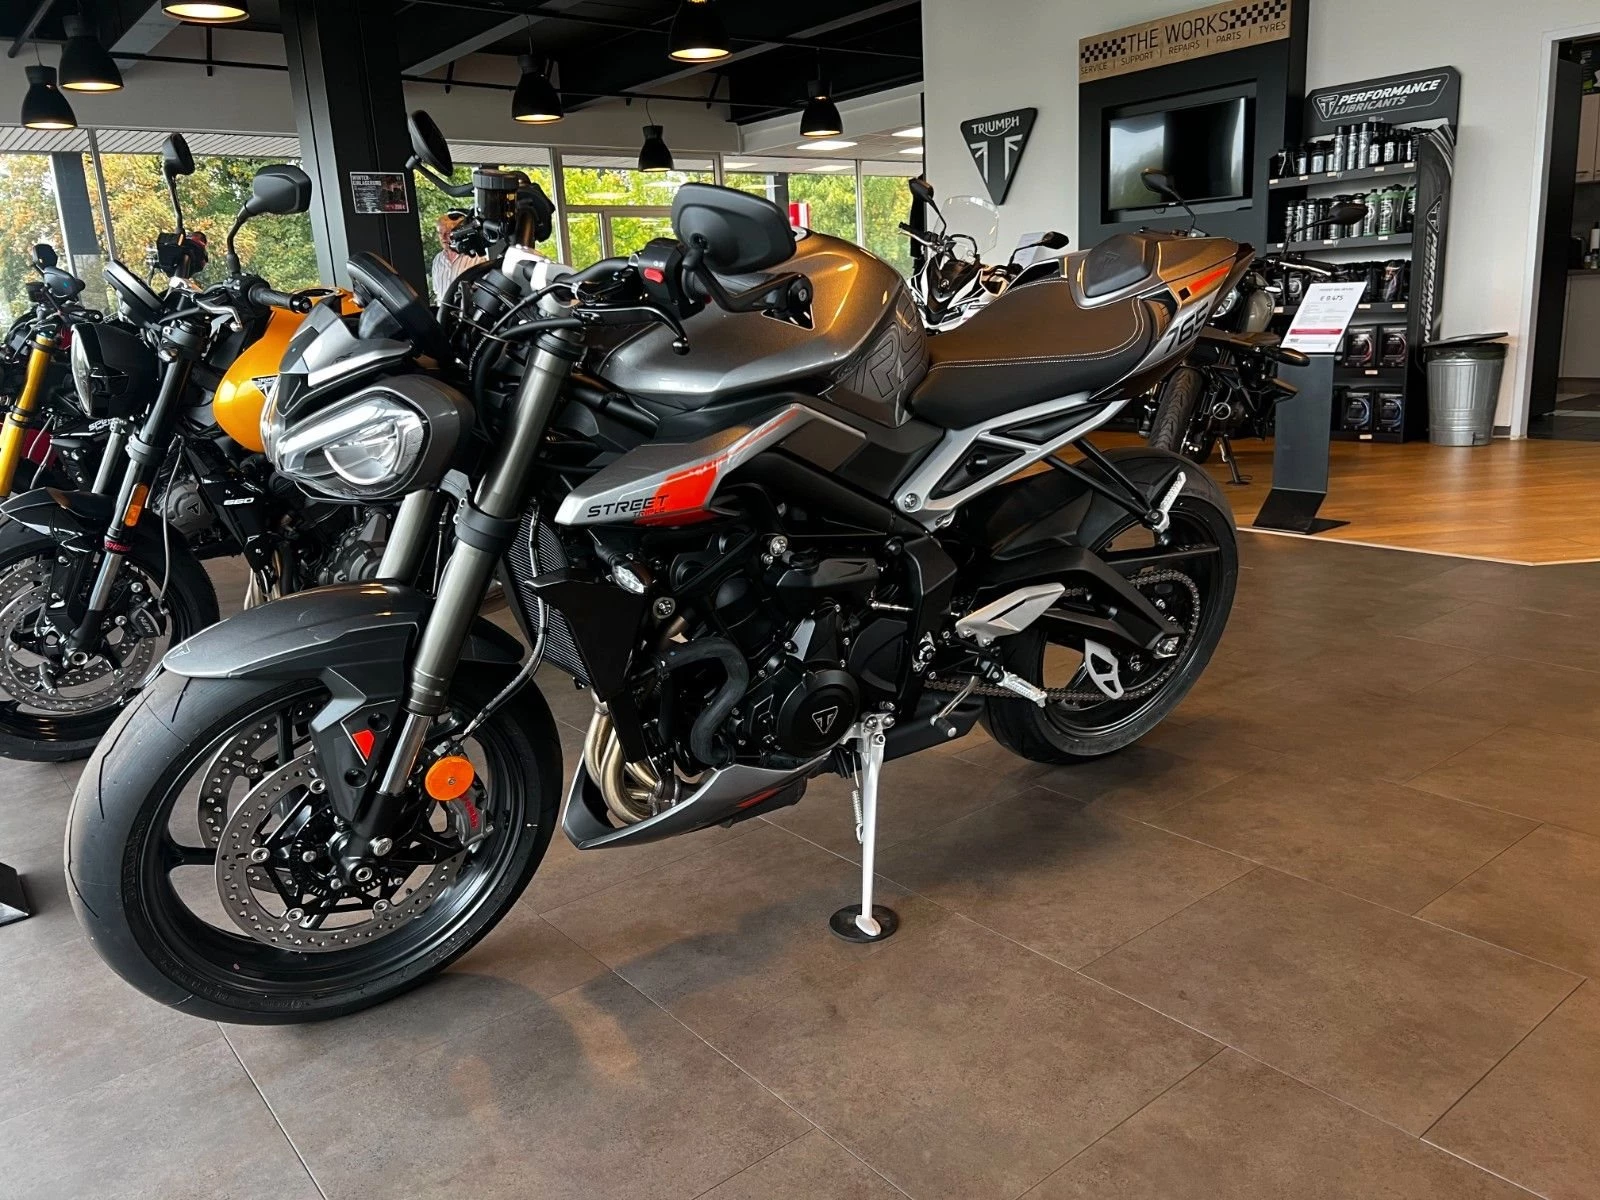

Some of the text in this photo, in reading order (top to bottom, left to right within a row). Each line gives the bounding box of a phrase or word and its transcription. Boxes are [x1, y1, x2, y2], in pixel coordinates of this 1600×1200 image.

[1127, 10, 1229, 53] THE WORKS
[1080, 21, 1287, 75] SERVICE SUPPORT REPAIRS PARTS TYRES
[1333, 95, 1408, 115] LUBRICANTS
[1338, 79, 1441, 106] PERFORMANCE
[971, 116, 1020, 135] TRIUMPH
[1424, 232, 1438, 343] PERFORMAN
[1164, 301, 1209, 354] 765
[223, 497, 255, 506] 660
[587, 494, 669, 518] STREET
